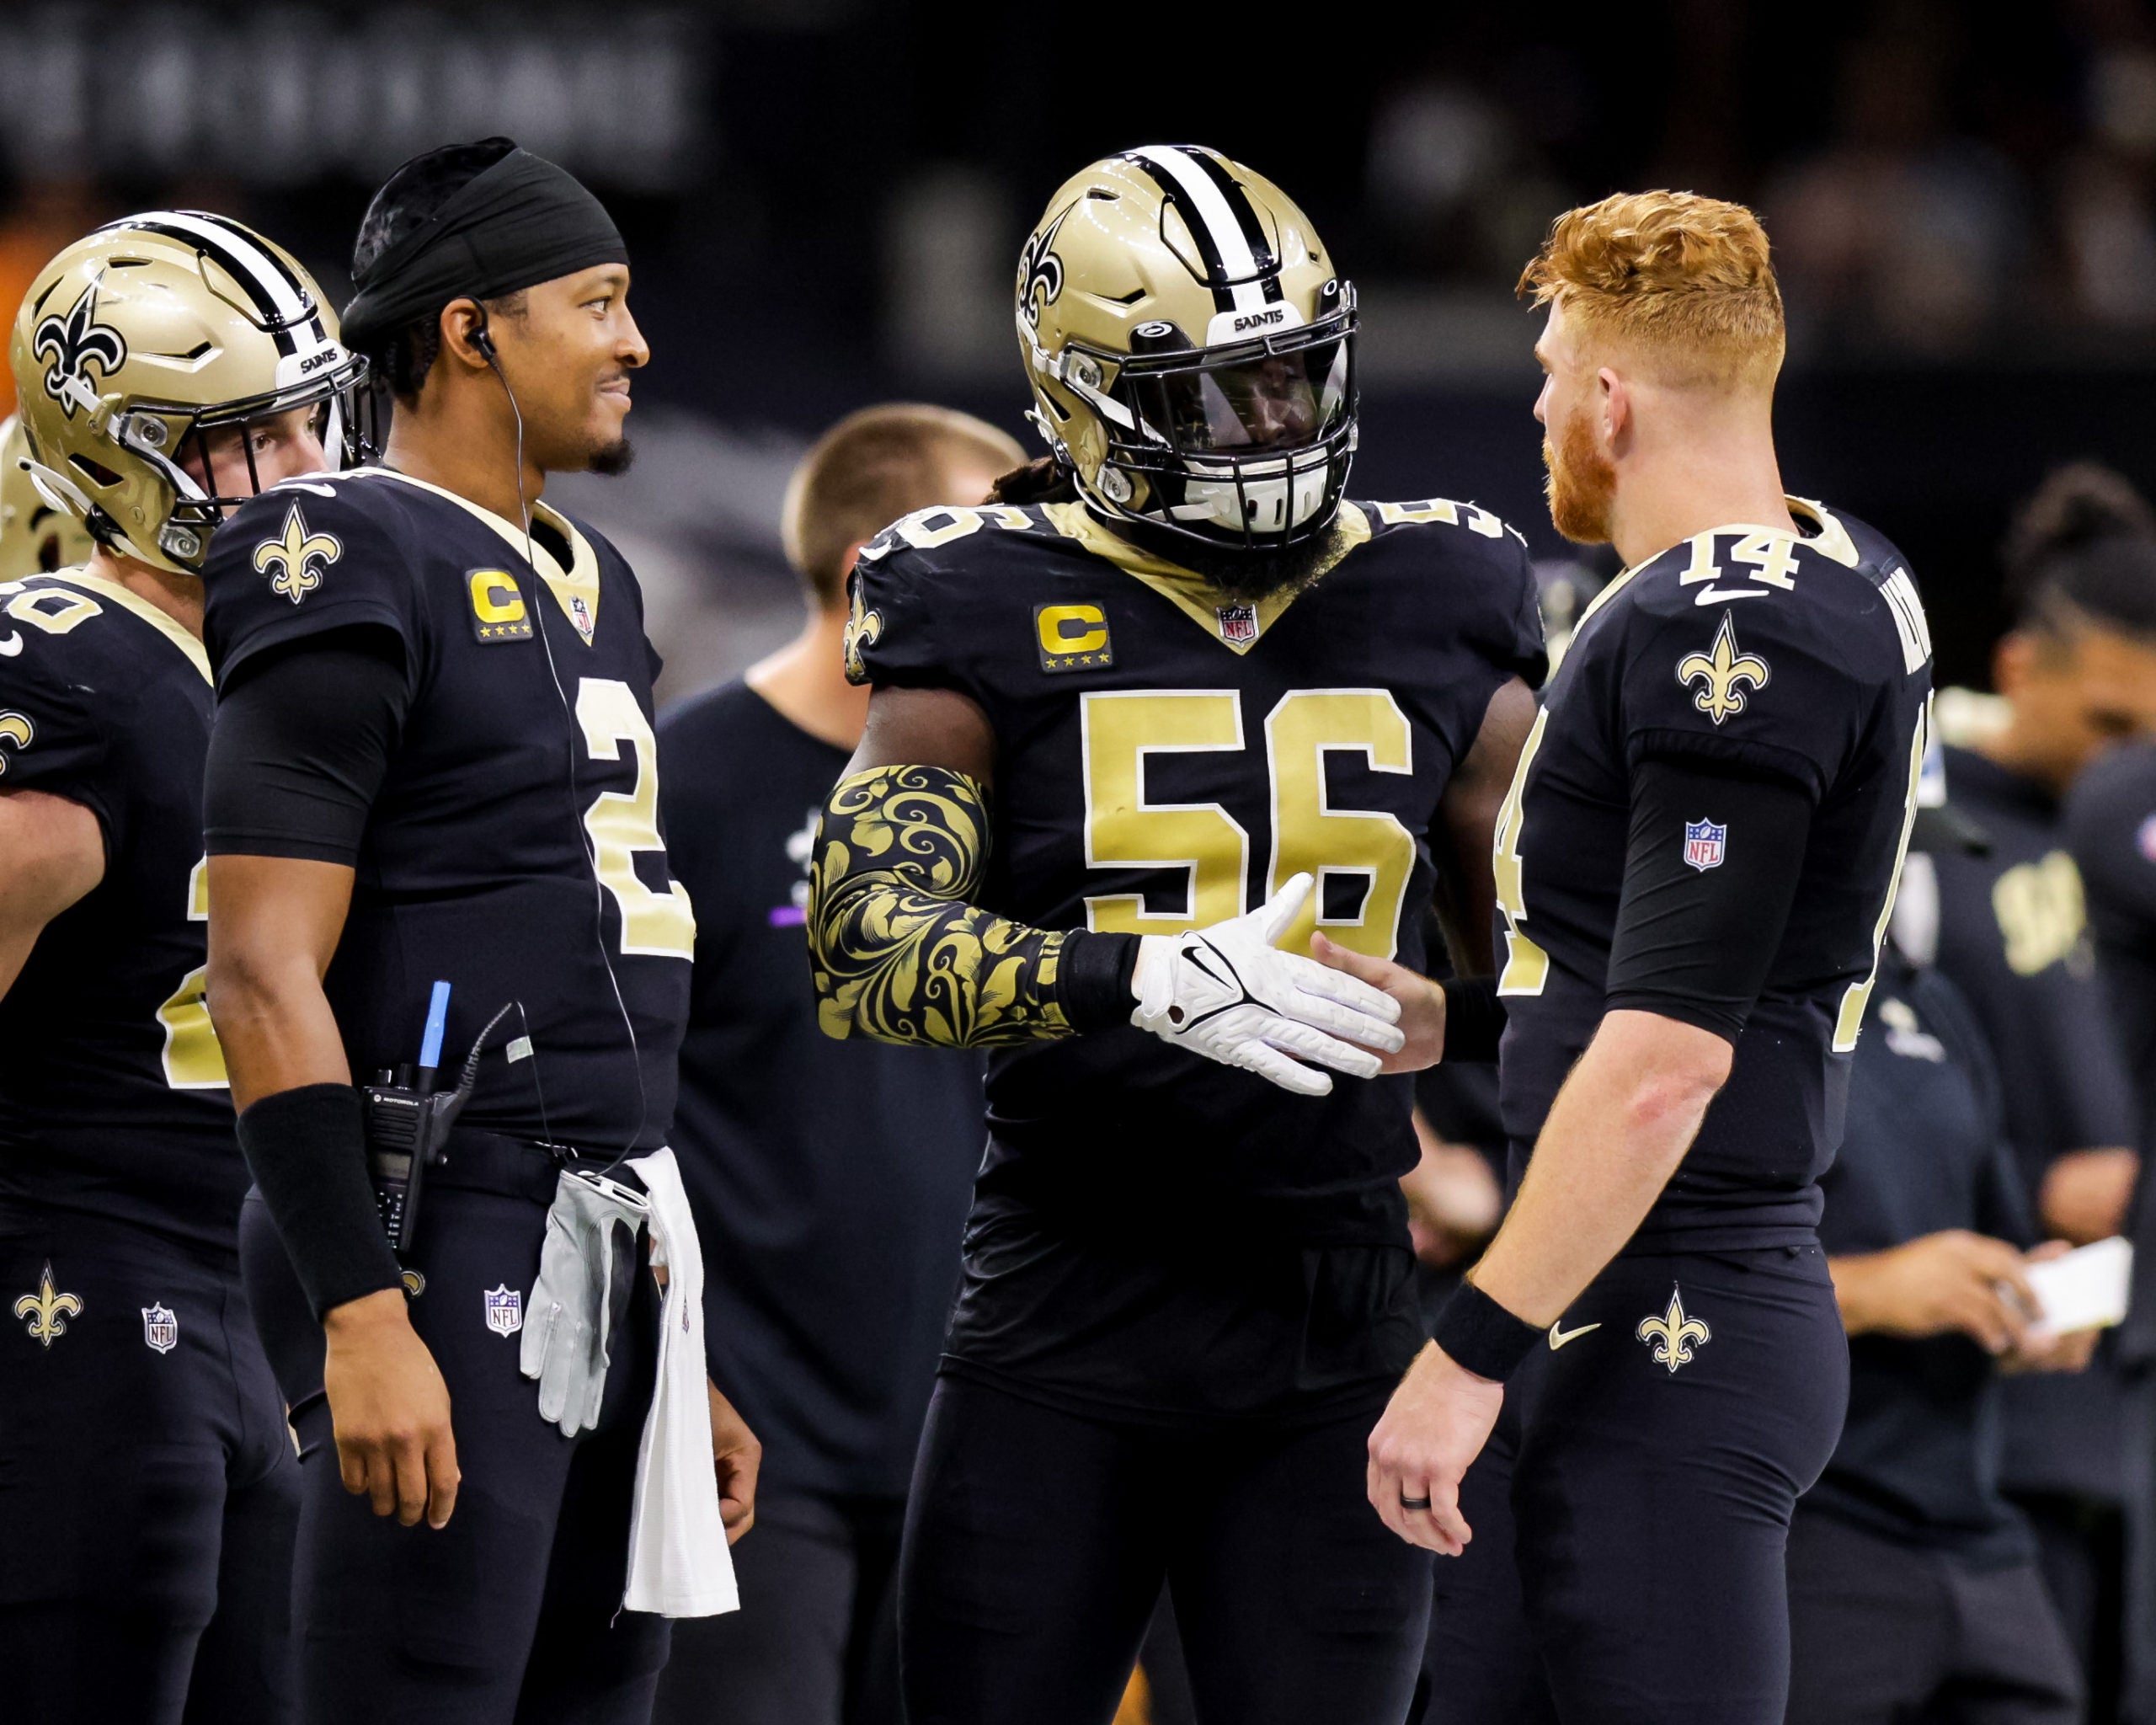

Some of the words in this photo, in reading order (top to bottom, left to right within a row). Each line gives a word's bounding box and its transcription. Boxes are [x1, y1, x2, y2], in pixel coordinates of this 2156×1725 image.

[1234, 309, 1284, 332] SAINTS
[300, 347, 337, 374] SAINTS
[1680, 533, 1801, 591] 14
[470, 571, 525, 623] C
[1038, 605, 1107, 655] C
[1225, 622, 1251, 638] NFL
[575, 677, 696, 963] 2
[1080, 688, 1417, 961] 56
[1689, 841, 1719, 864] NFL
[383, 1097, 419, 1107] MOTOROLA
[493, 1308, 517, 1327] NFL
[151, 1326, 173, 1344] NFL
